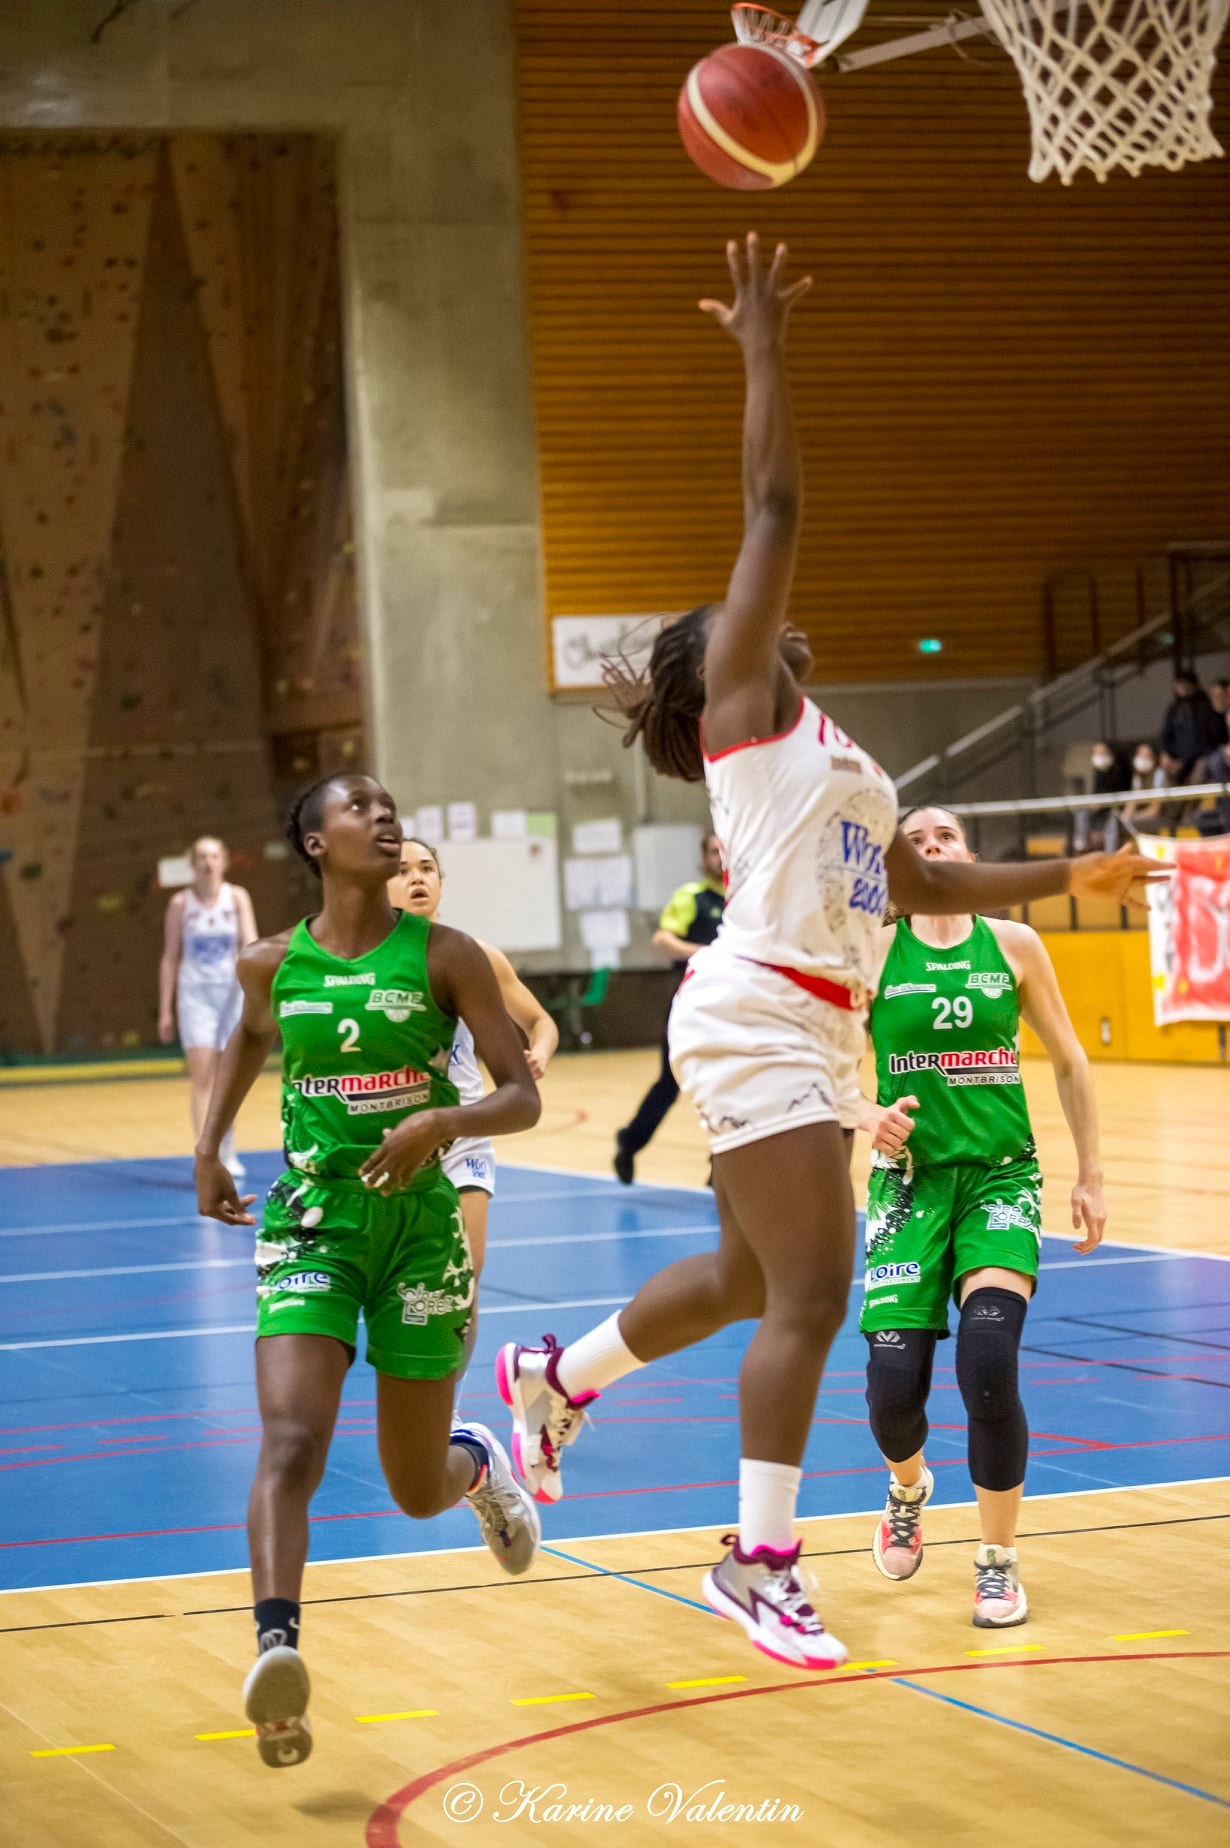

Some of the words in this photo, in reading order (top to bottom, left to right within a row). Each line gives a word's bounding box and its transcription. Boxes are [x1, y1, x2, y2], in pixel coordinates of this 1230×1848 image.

[925, 961, 971, 972] SPALDING
[970, 973, 1010, 985] BCME
[372, 991, 423, 1004] BCME
[931, 995, 974, 1030] 29
[336, 1017, 362, 1054] 2
[949, 1075, 1020, 1085] MONTBRISON
[350, 1094, 430, 1113] MONTBRISON
[278, 1271, 329, 1289] oire
